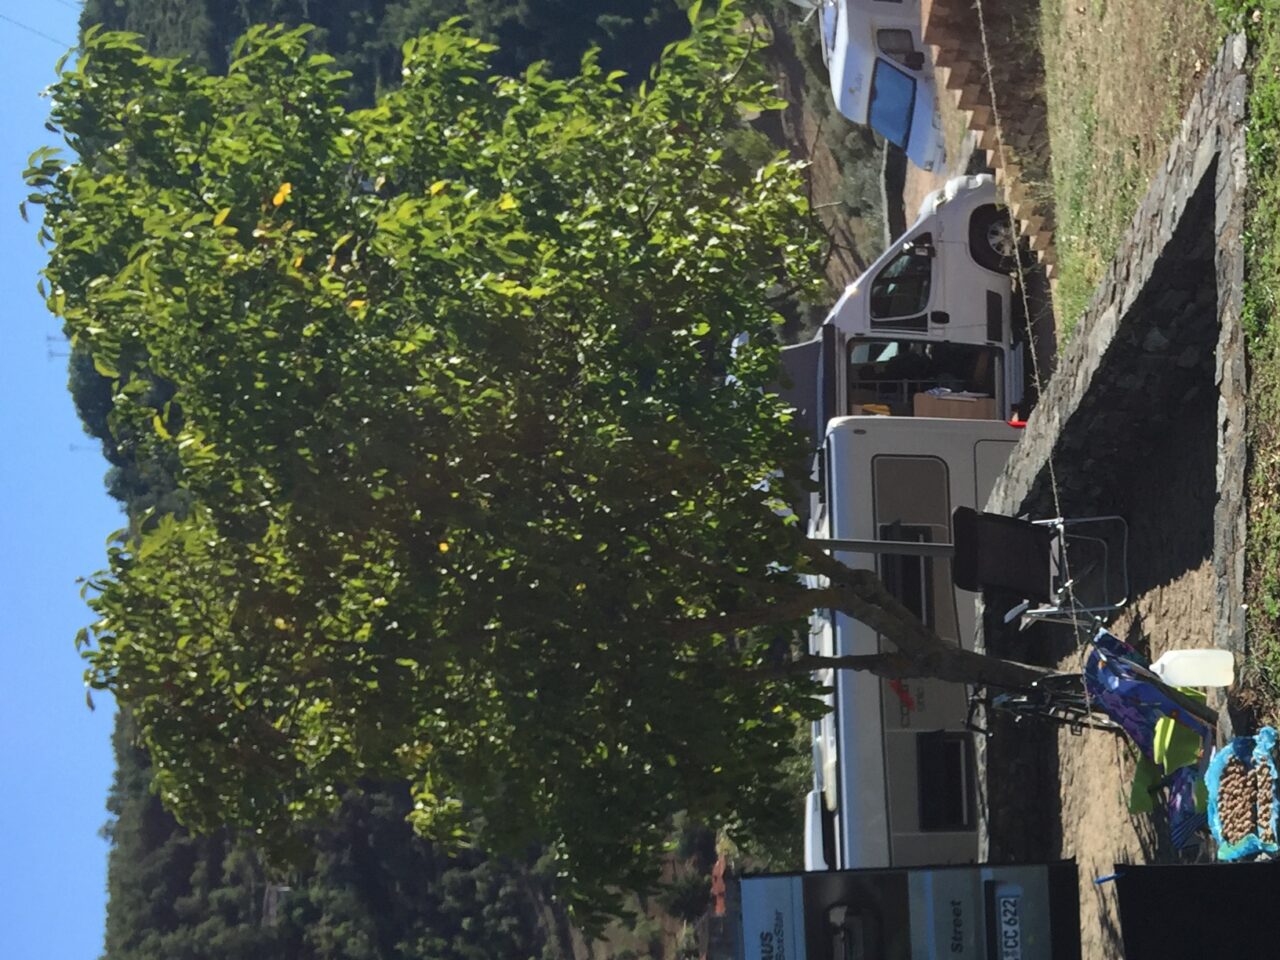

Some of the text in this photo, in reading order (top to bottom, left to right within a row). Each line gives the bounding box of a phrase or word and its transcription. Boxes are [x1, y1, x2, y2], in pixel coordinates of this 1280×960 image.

[950, 900, 963, 953] Street
[1002, 899, 1018, 927] 622
[1004, 930, 1019, 949] CC
